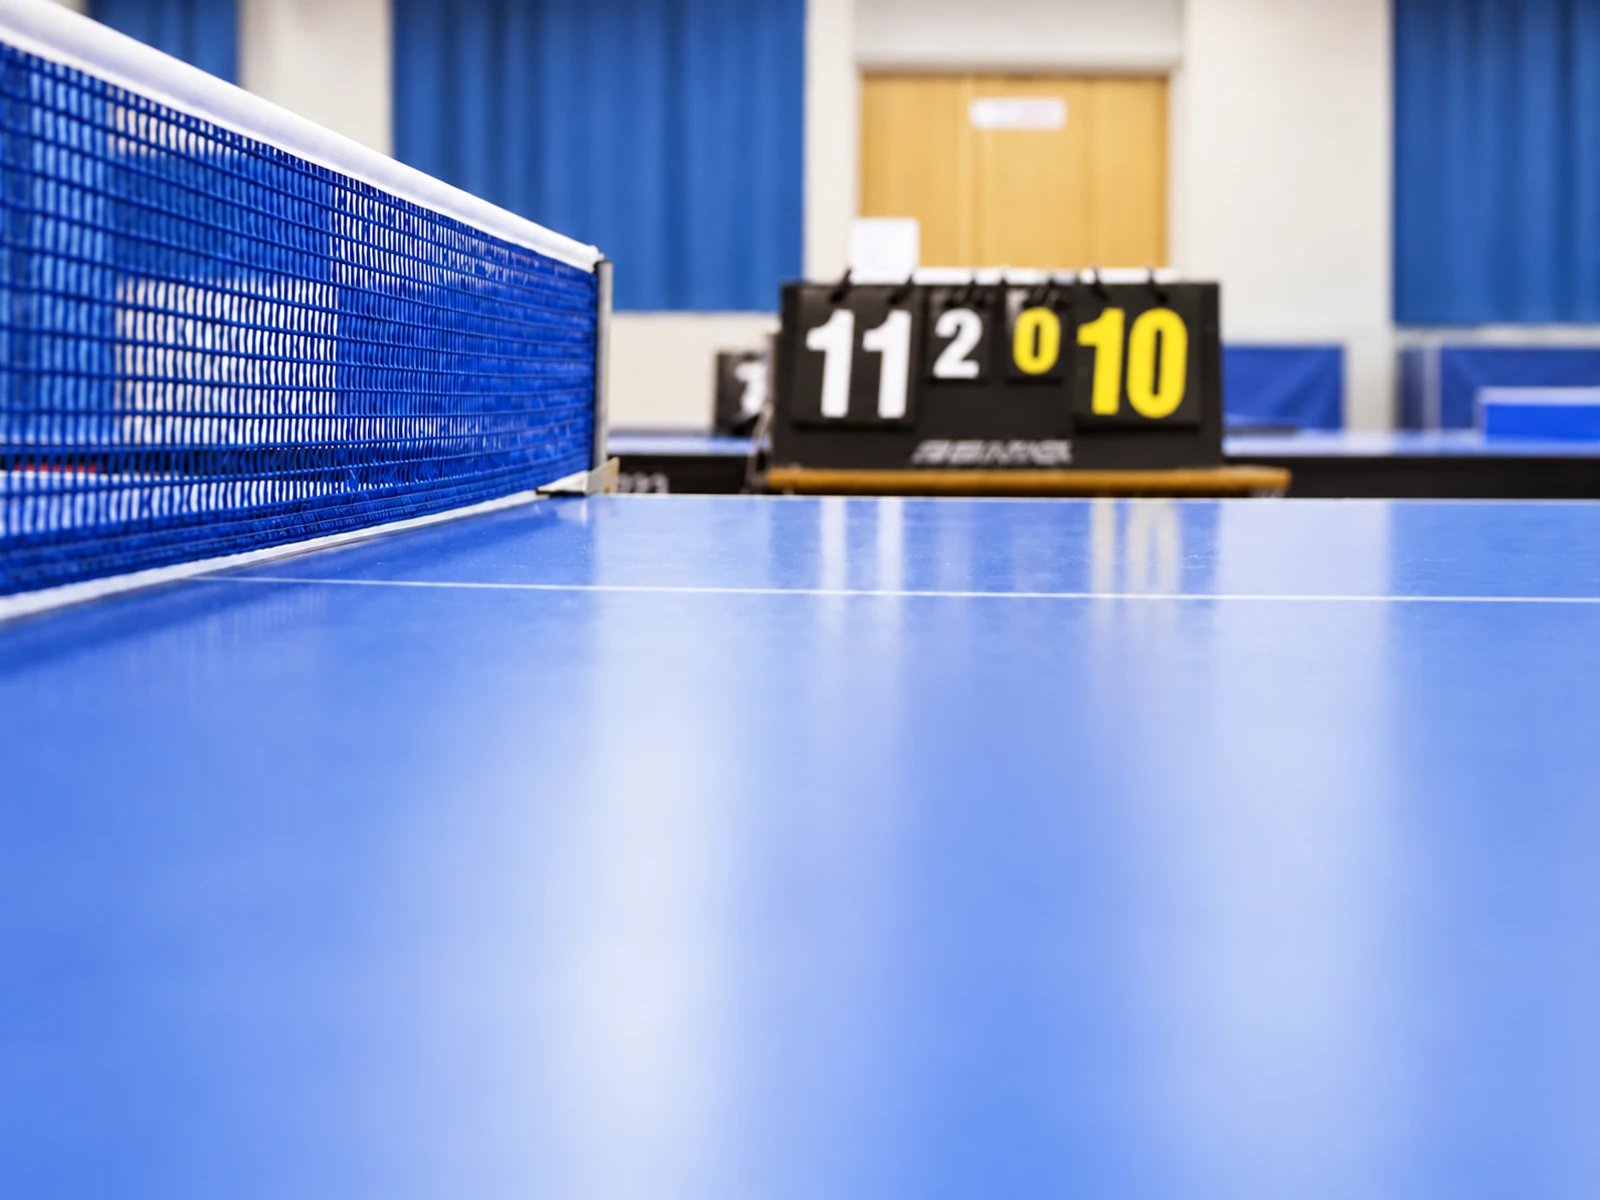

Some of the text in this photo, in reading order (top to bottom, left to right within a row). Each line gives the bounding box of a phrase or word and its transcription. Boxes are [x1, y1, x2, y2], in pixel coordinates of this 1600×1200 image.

[806, 309, 912, 419] 11
[933, 308, 983, 379] 2
[1012, 307, 1061, 375] 0
[1076, 307, 1188, 419] 10
